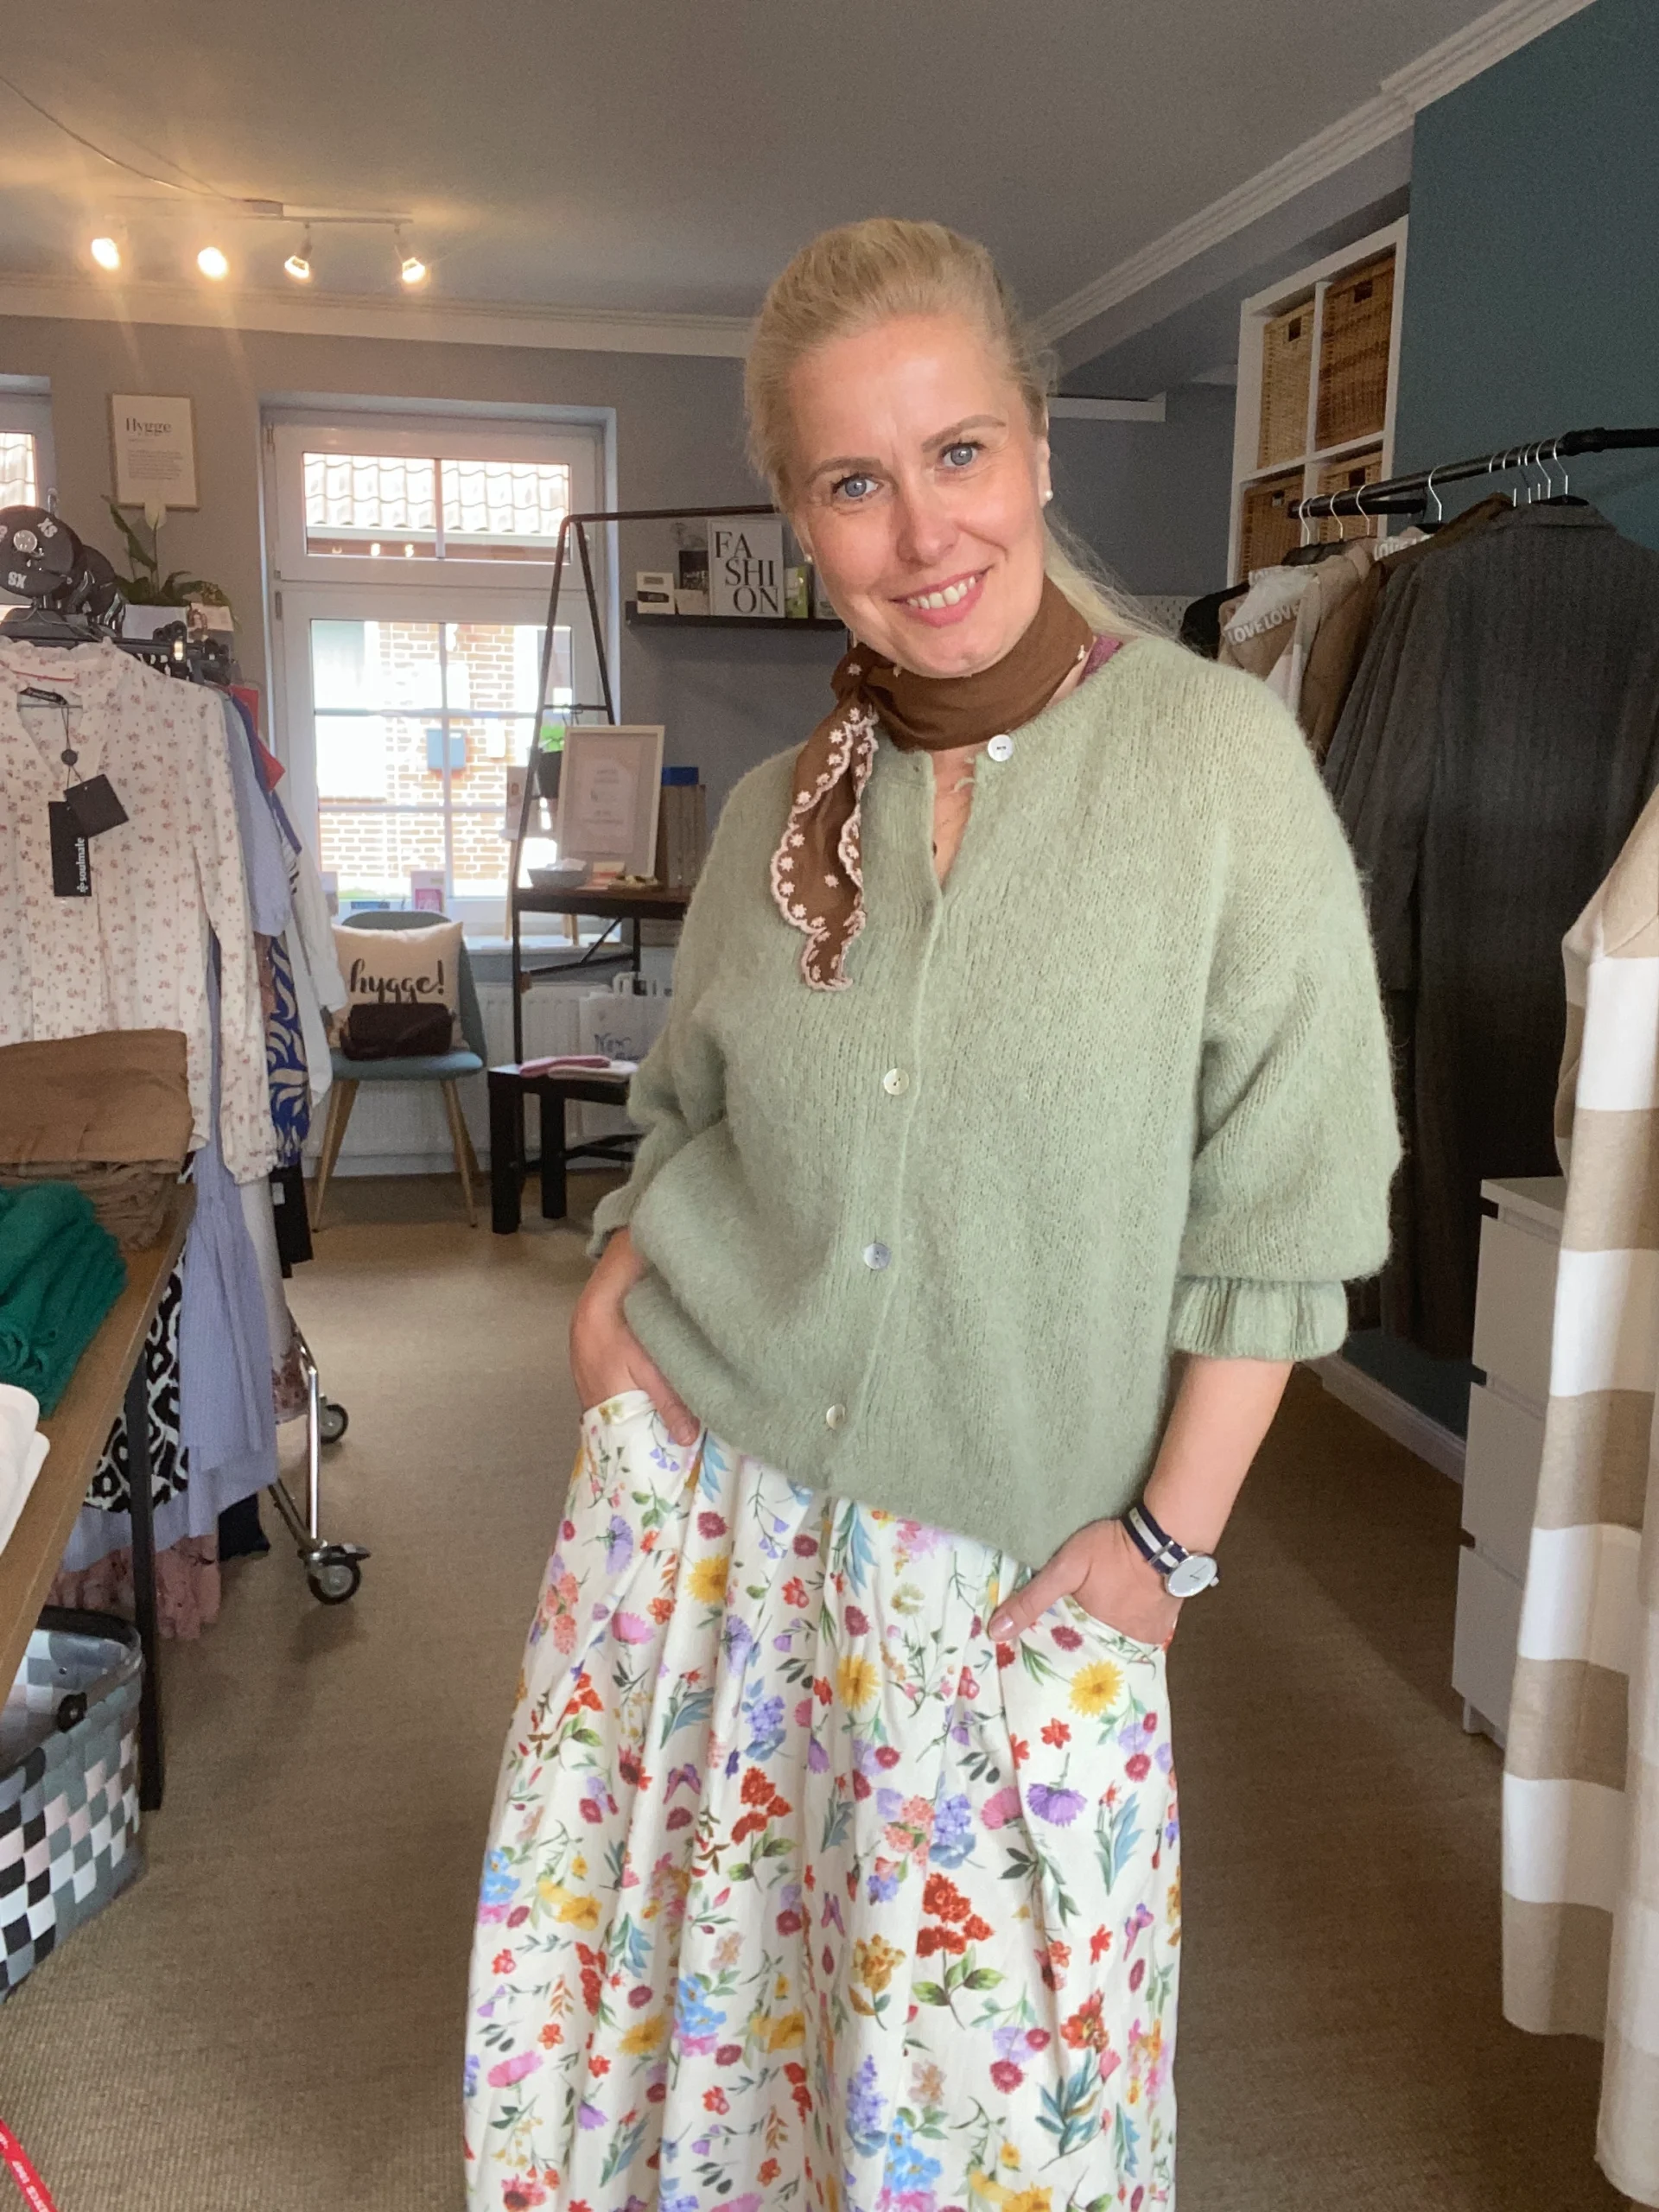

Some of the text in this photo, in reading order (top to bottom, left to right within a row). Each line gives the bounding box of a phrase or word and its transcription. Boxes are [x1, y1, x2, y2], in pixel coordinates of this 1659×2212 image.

[125, 417, 171, 436] Hygge
[37, 518, 58, 537] XS
[715, 531, 753, 558] FA
[8, 571, 27, 588] XS
[725, 558, 776, 587] SHI
[733, 587, 779, 614] ON
[1228, 621, 1265, 645] LOVE
[75, 836, 87, 881] soulmate
[350, 958, 444, 1003] hygge!
